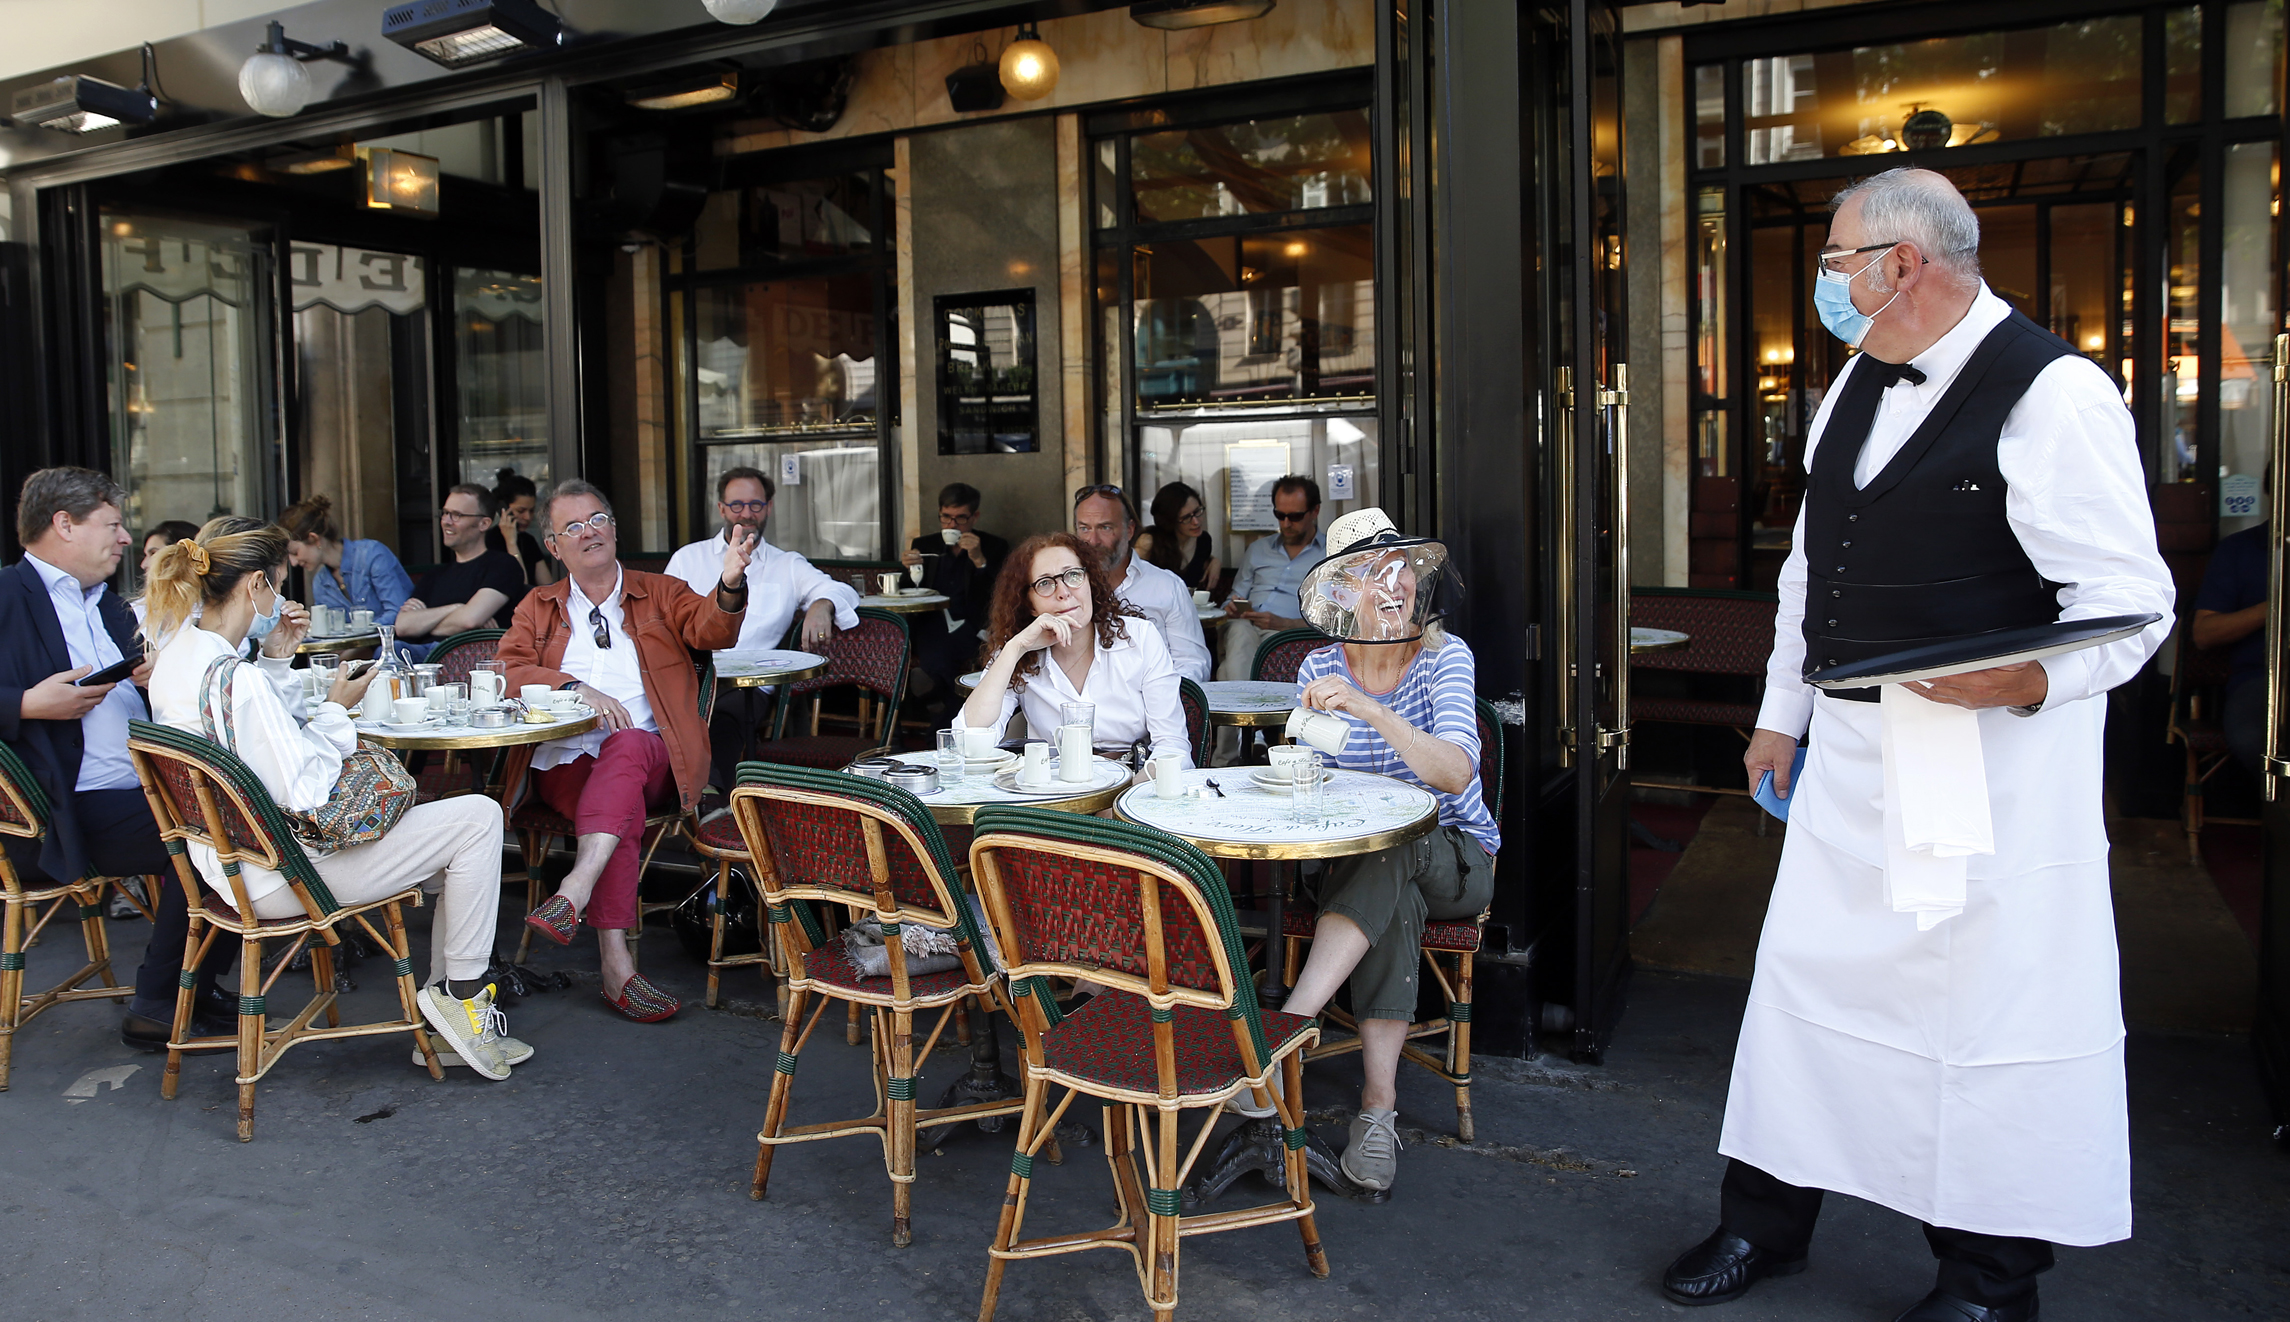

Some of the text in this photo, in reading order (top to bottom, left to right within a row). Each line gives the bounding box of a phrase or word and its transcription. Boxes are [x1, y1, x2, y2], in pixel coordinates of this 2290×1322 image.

[944, 303, 1026, 322] COCKAIS
[947, 358, 1025, 374] BREAKT
[959, 404, 1016, 415] SANDWICH
